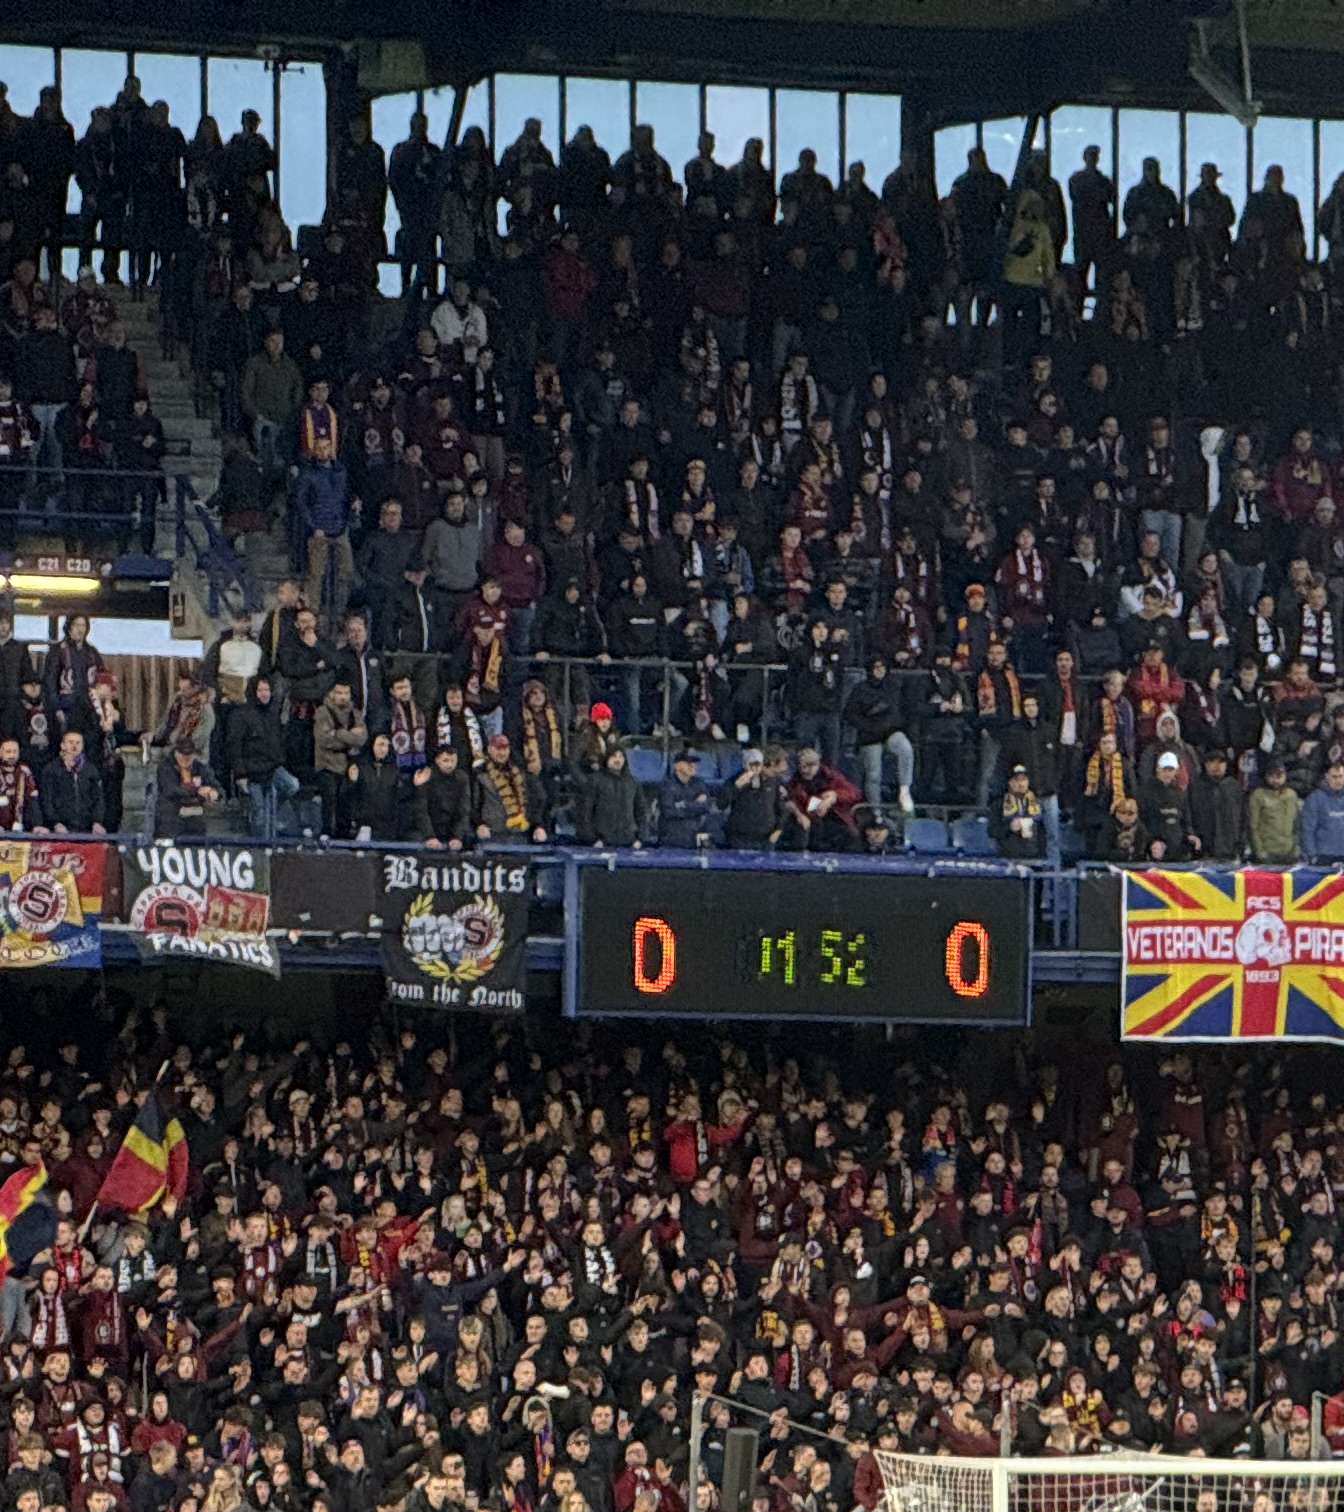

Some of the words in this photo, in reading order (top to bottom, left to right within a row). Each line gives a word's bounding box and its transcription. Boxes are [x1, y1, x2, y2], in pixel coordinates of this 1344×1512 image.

[137, 847, 255, 889] YOUNG
[384, 855, 527, 893] Bandits
[147, 933, 275, 968] FANATICS
[633, 915, 676, 993] 0
[946, 920, 989, 997] 0
[1127, 926, 1234, 960] VETERANOS
[388, 979, 424, 1000] rom
[432, 983, 460, 1005] the
[467, 985, 525, 1009] North
